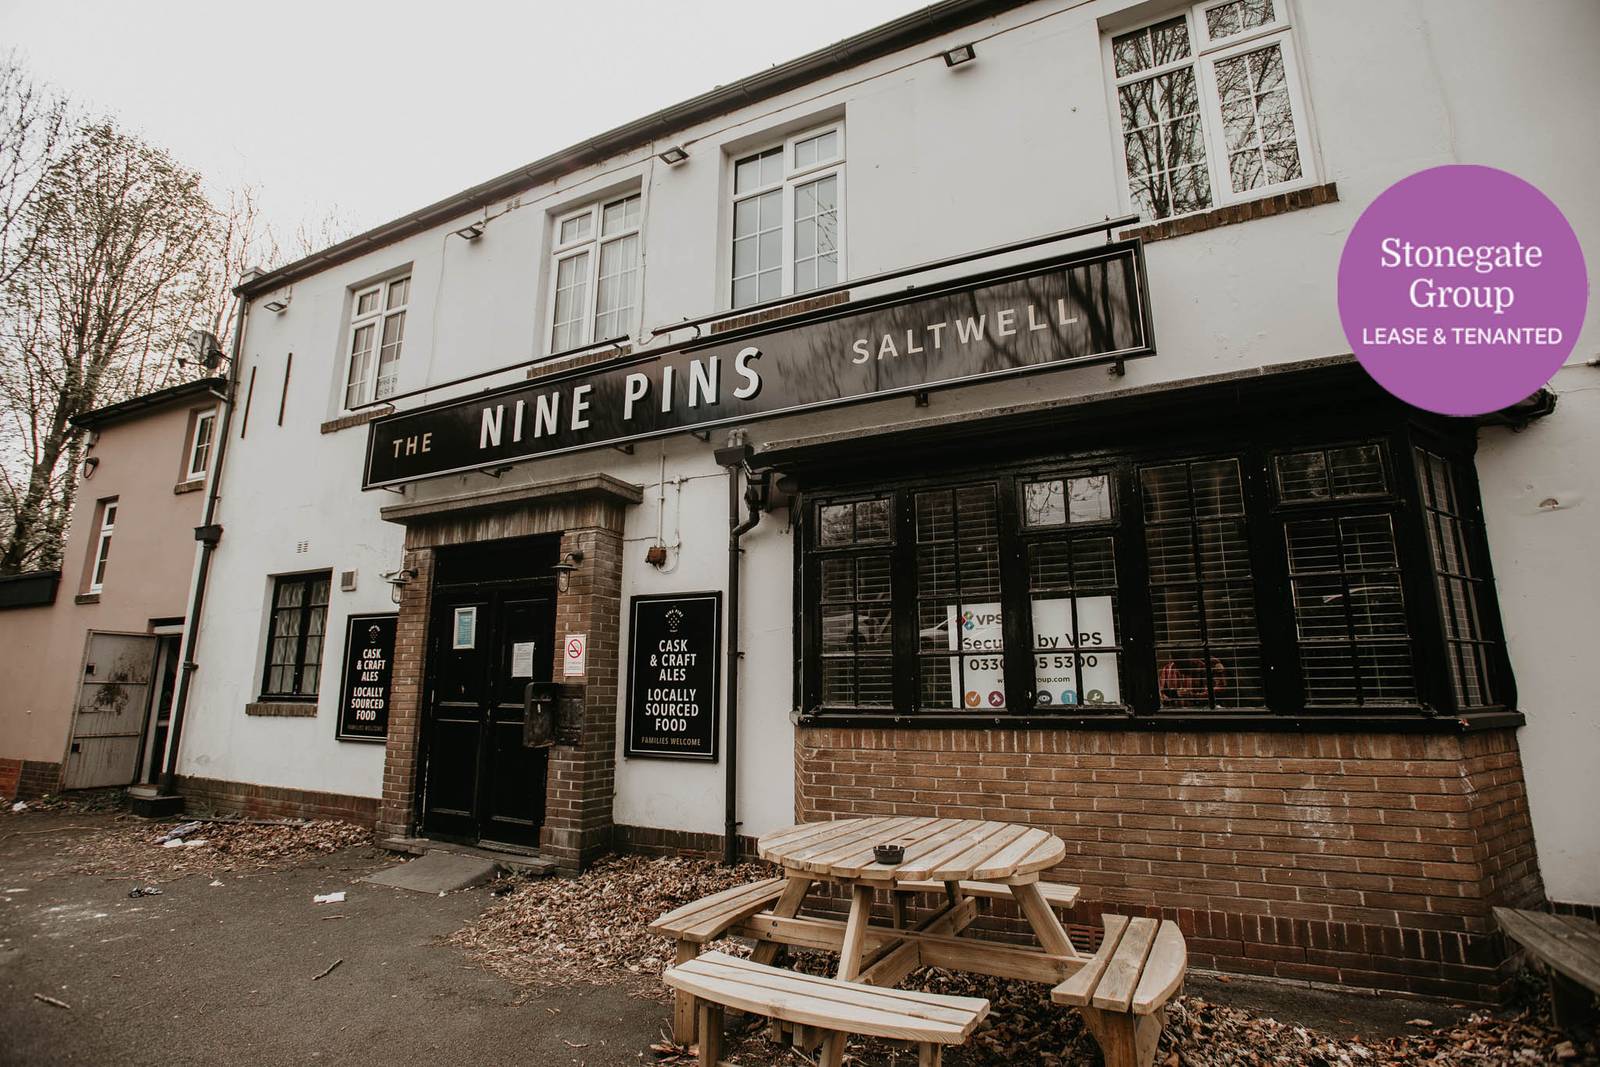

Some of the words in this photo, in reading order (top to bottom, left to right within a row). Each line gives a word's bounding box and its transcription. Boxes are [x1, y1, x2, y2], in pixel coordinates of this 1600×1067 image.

[851, 298, 1078, 365] SALTWELL
[392, 432, 434, 459] THE
[479, 384, 594, 450] NINE
[623, 346, 763, 421] PINS
[976, 613, 1002, 626] VPS
[658, 639, 688, 652] CASK
[962, 637, 1003, 650] Secu
[1038, 634, 1059, 648] by
[1065, 632, 1103, 646] VPS
[362, 648, 382, 659] CASK
[650, 654, 658, 667] &
[661, 653, 697, 667] CRAFT
[356, 660, 362, 670] &
[363, 660, 386, 670] CRAFT
[361, 671, 379, 682] ALES
[659, 668, 686, 681] ALES
[353, 686, 384, 697] LOCALLY
[647, 688, 697, 702] LOCALLY
[350, 698, 384, 709] SOURCED
[645, 703, 699, 717] SOURCED
[356, 710, 376, 721] FOOD
[655, 718, 687, 731] FOOD
[641, 736, 669, 745] FAMILIES
[670, 737, 701, 746] WELCOME
